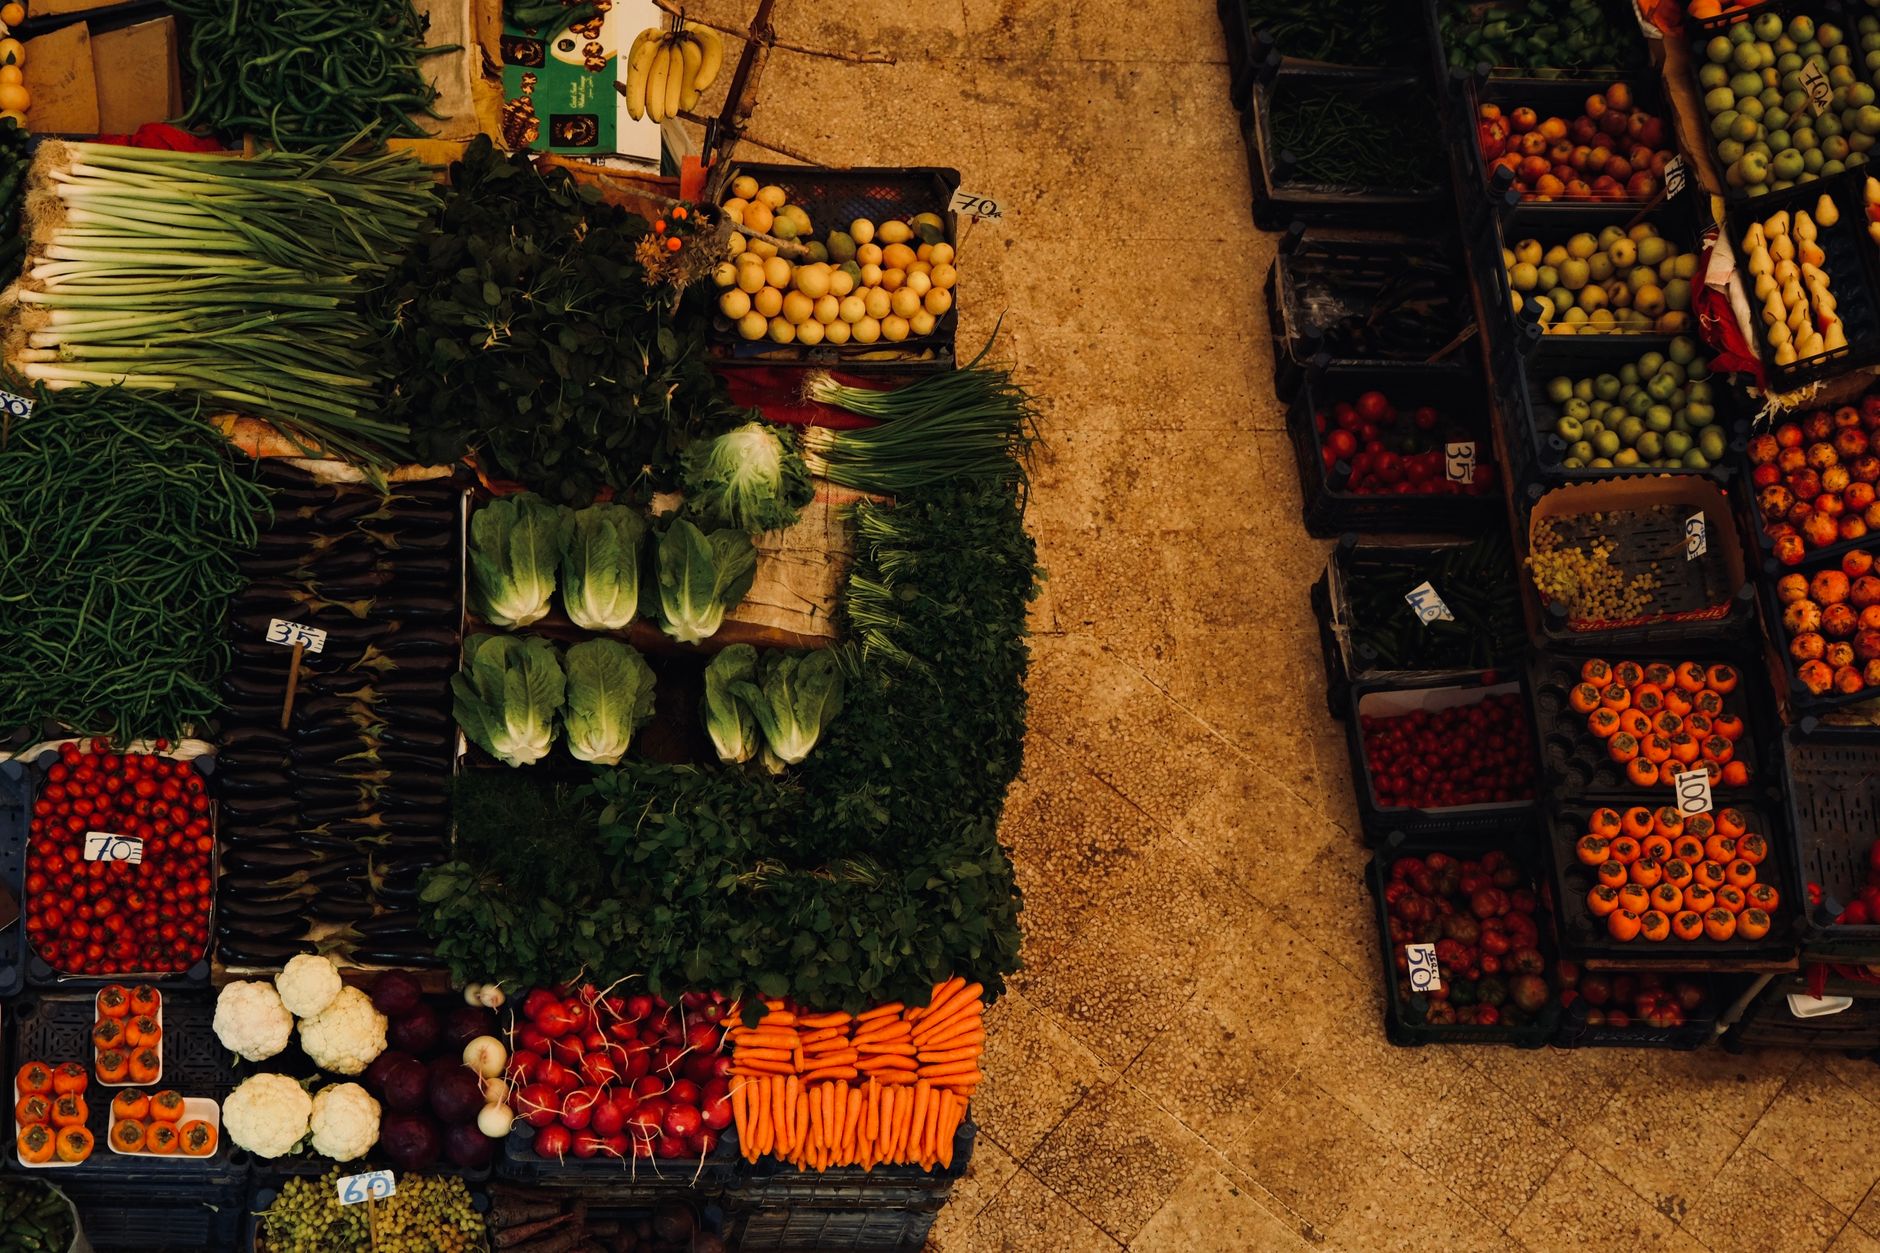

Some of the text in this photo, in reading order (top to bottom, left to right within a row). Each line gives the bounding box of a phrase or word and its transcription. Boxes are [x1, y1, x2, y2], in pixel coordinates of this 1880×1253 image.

[956, 193, 997, 216] 70
[1446, 446, 1472, 481] 35
[267, 624, 320, 649] 35
[1679, 774, 1707, 813] 100
[90, 836, 131, 861] 70
[1407, 948, 1431, 988] 50
[344, 1176, 391, 1202] 60
